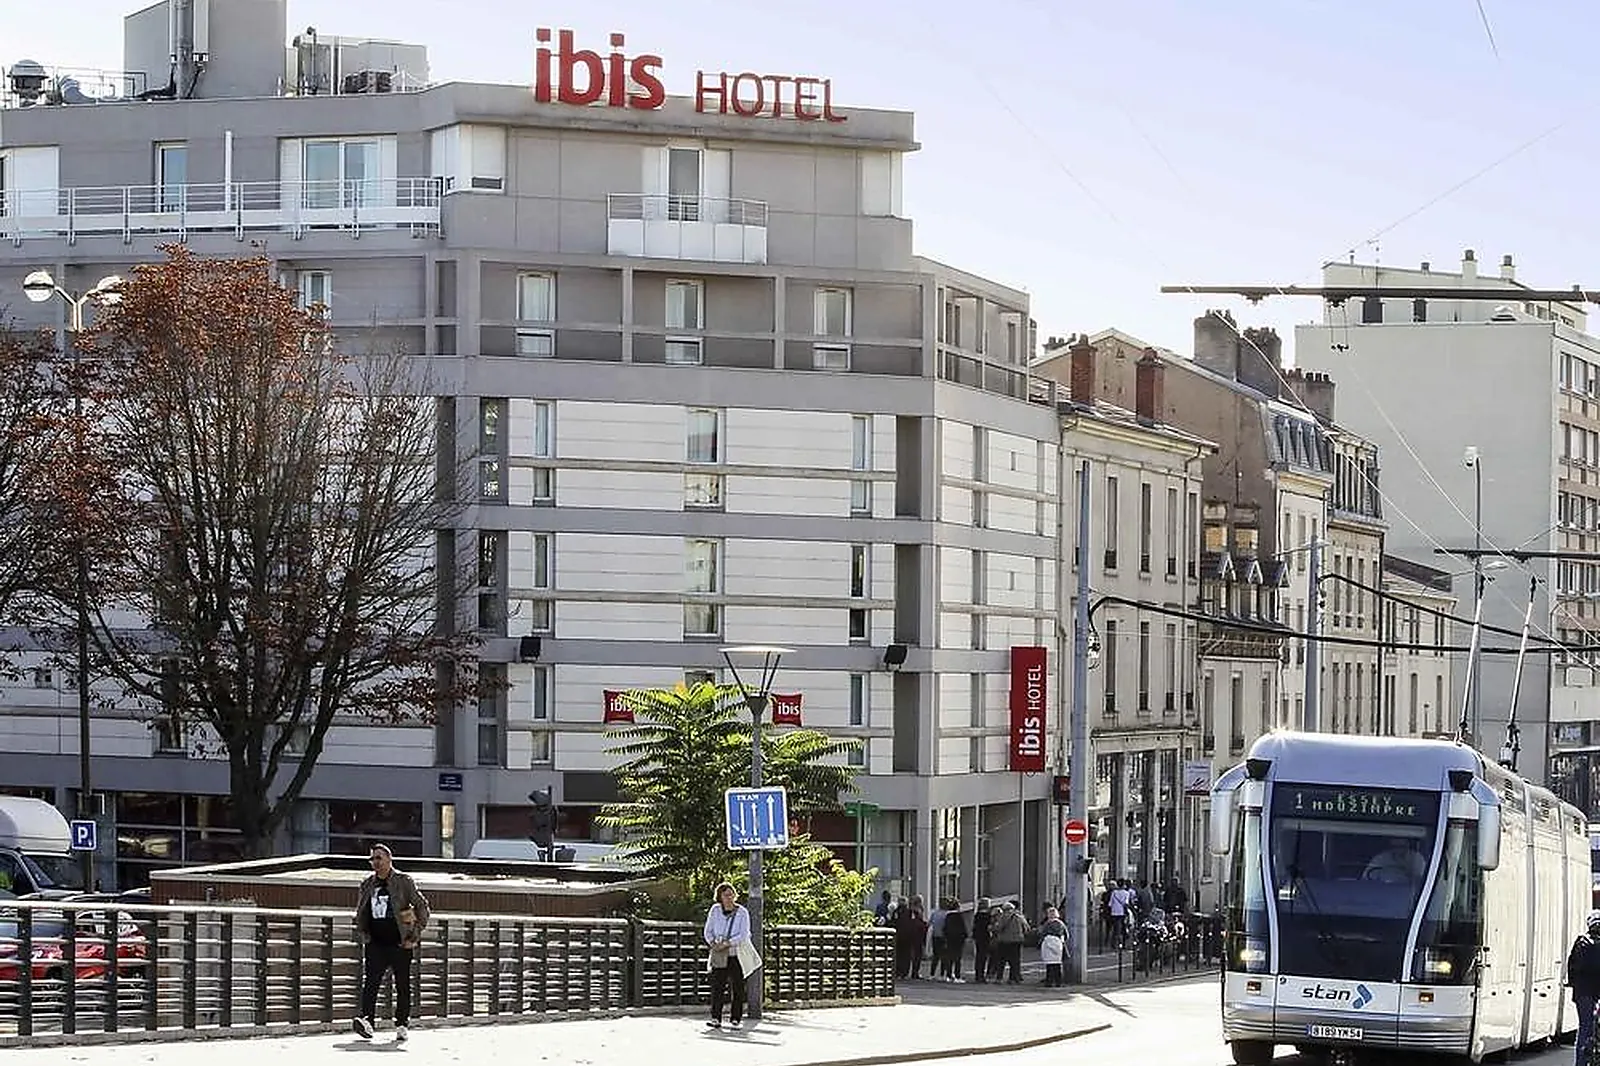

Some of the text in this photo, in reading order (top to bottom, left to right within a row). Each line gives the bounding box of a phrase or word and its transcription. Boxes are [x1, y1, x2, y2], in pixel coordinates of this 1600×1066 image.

[535, 28, 848, 122] ibis HOTEL
[777, 702, 800, 716] ibis
[1019, 664, 1042, 756] ibis HOTEL
[78, 826, 88, 844] P
[1302, 984, 1351, 1001] stan
